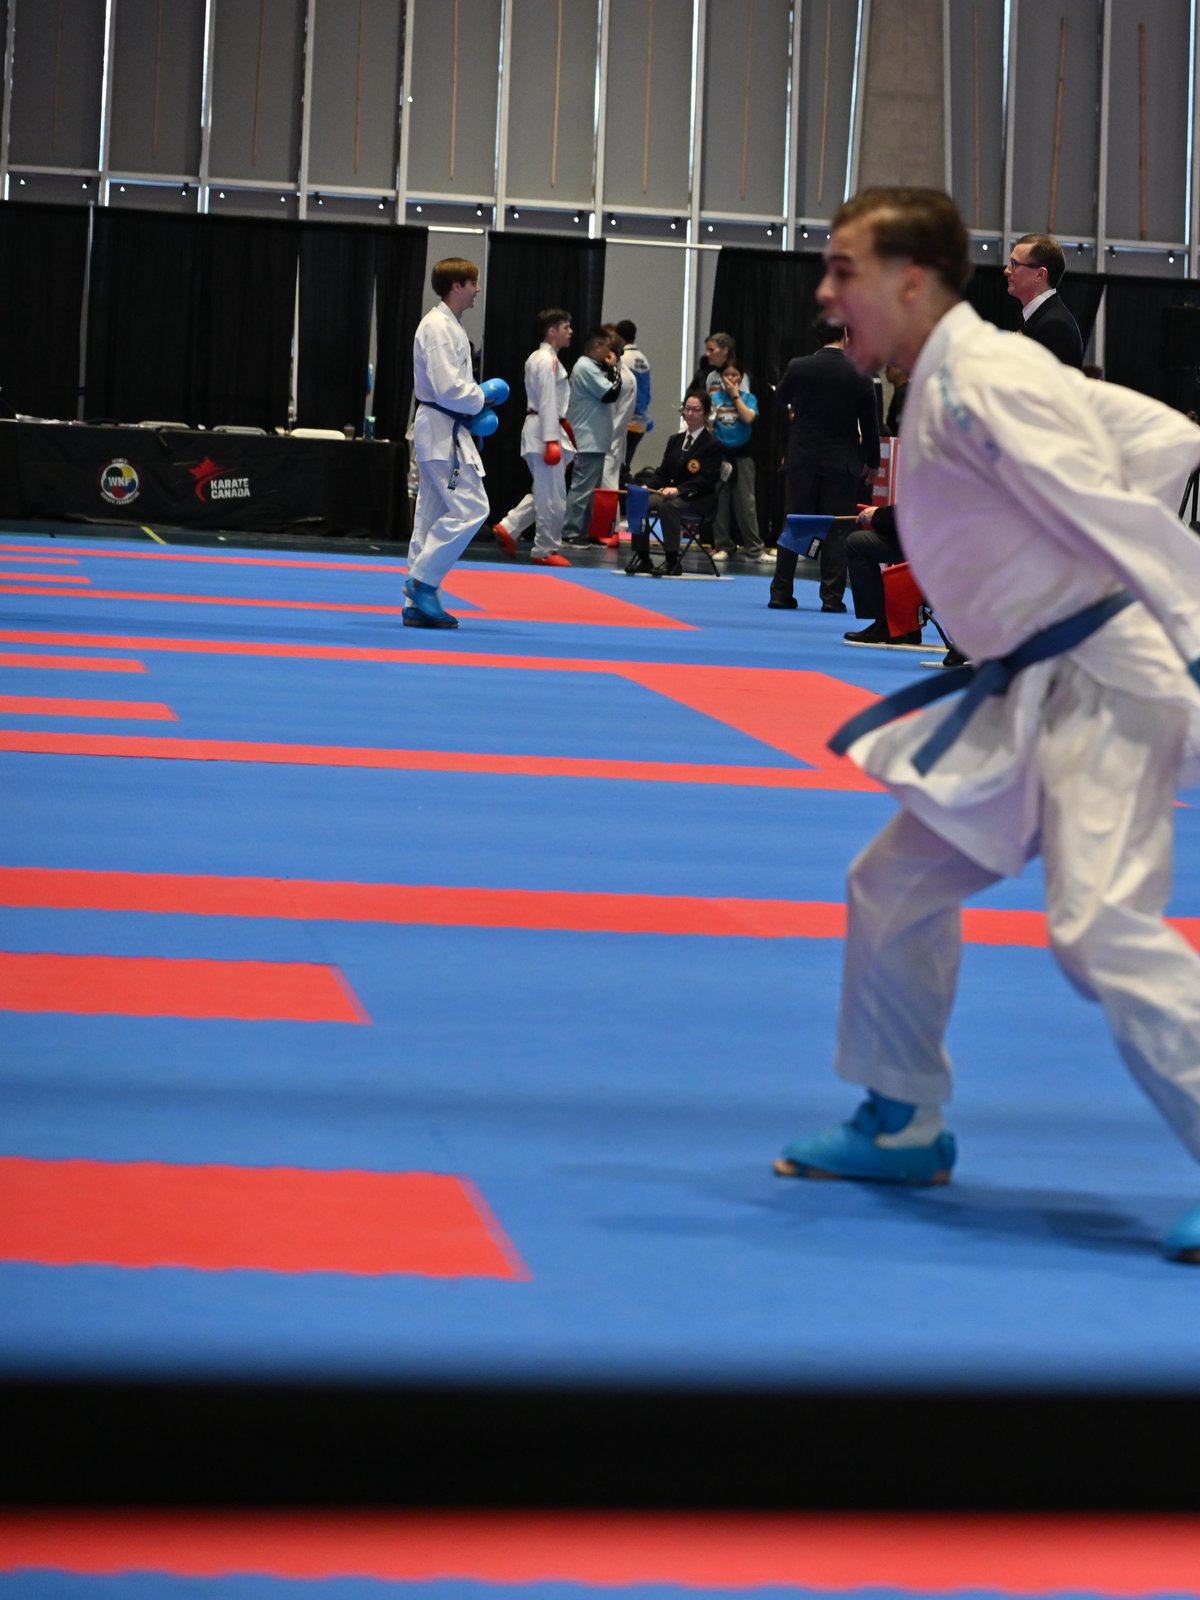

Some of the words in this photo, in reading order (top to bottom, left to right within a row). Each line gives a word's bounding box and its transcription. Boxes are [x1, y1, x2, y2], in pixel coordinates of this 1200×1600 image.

[108, 476, 132, 487] WKF
[210, 478, 249, 490] KARATE
[211, 488, 250, 500] CANADA
